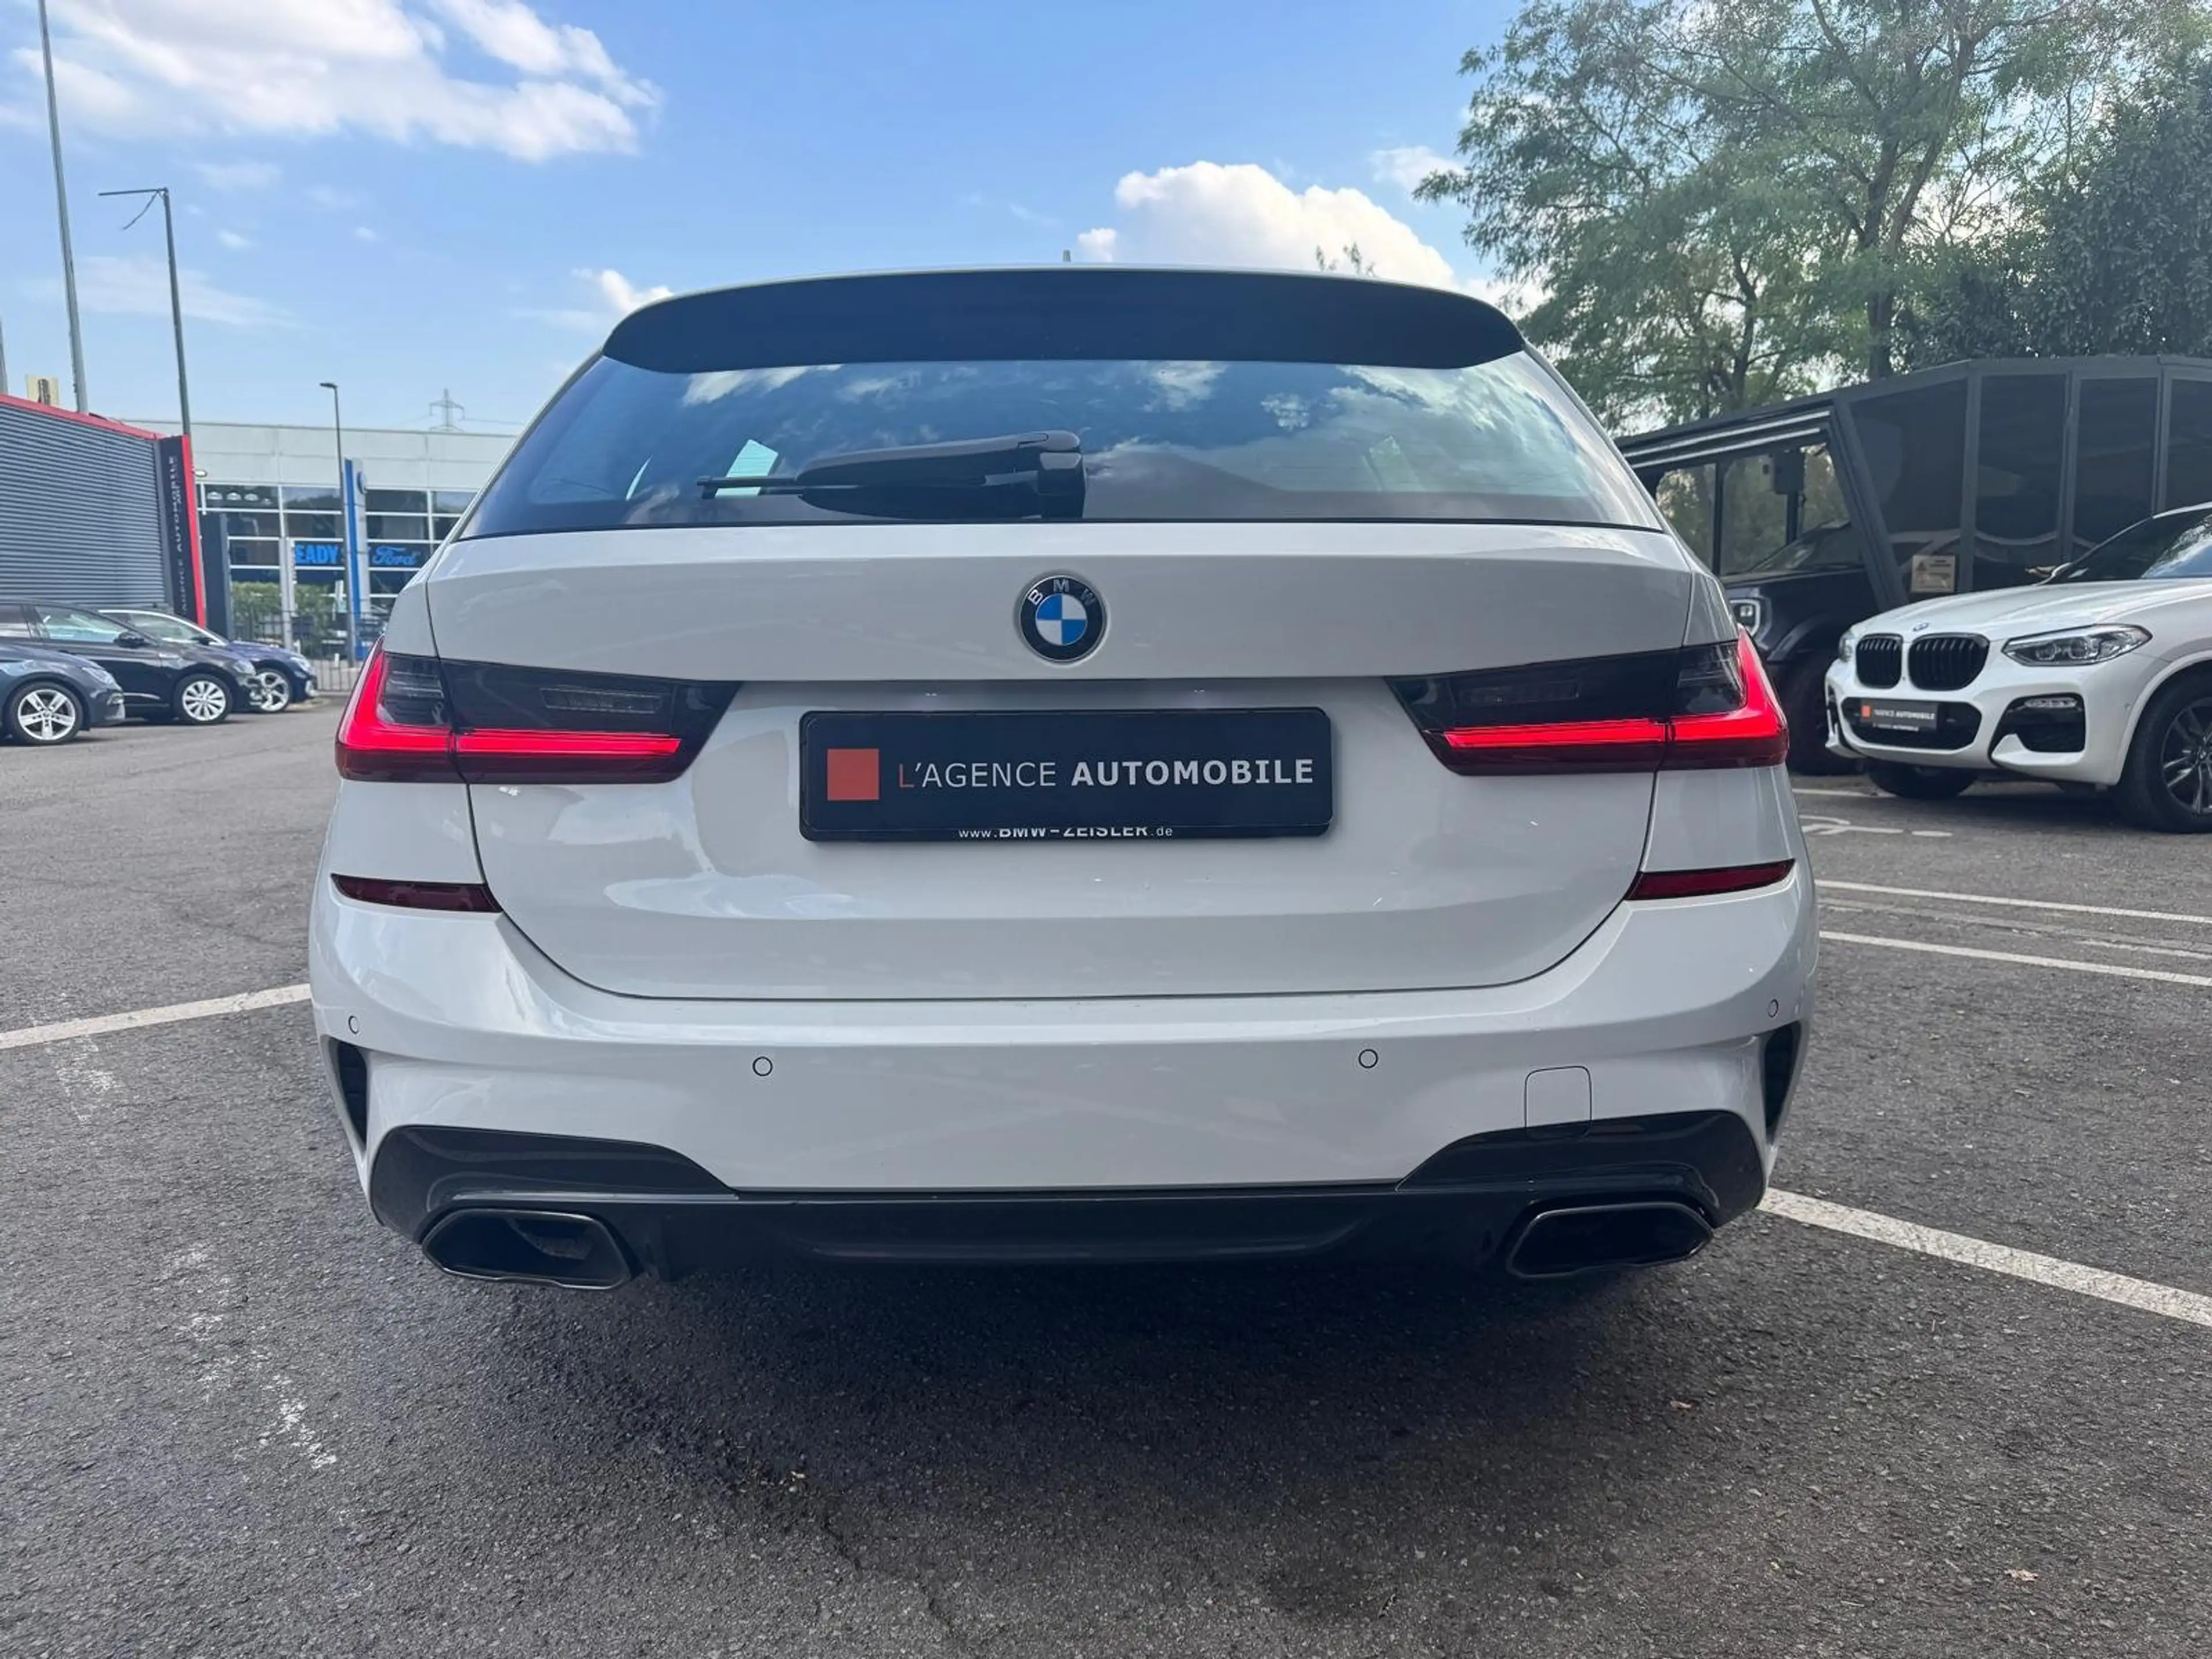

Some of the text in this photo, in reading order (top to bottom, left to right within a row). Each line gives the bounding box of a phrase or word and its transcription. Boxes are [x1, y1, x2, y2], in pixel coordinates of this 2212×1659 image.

[294, 544, 339, 564] EADY
[372, 546, 420, 565] Ford
[1028, 579, 1096, 605] BMW
[899, 760, 1314, 788] L'AGENCE AUTOMOBILE
